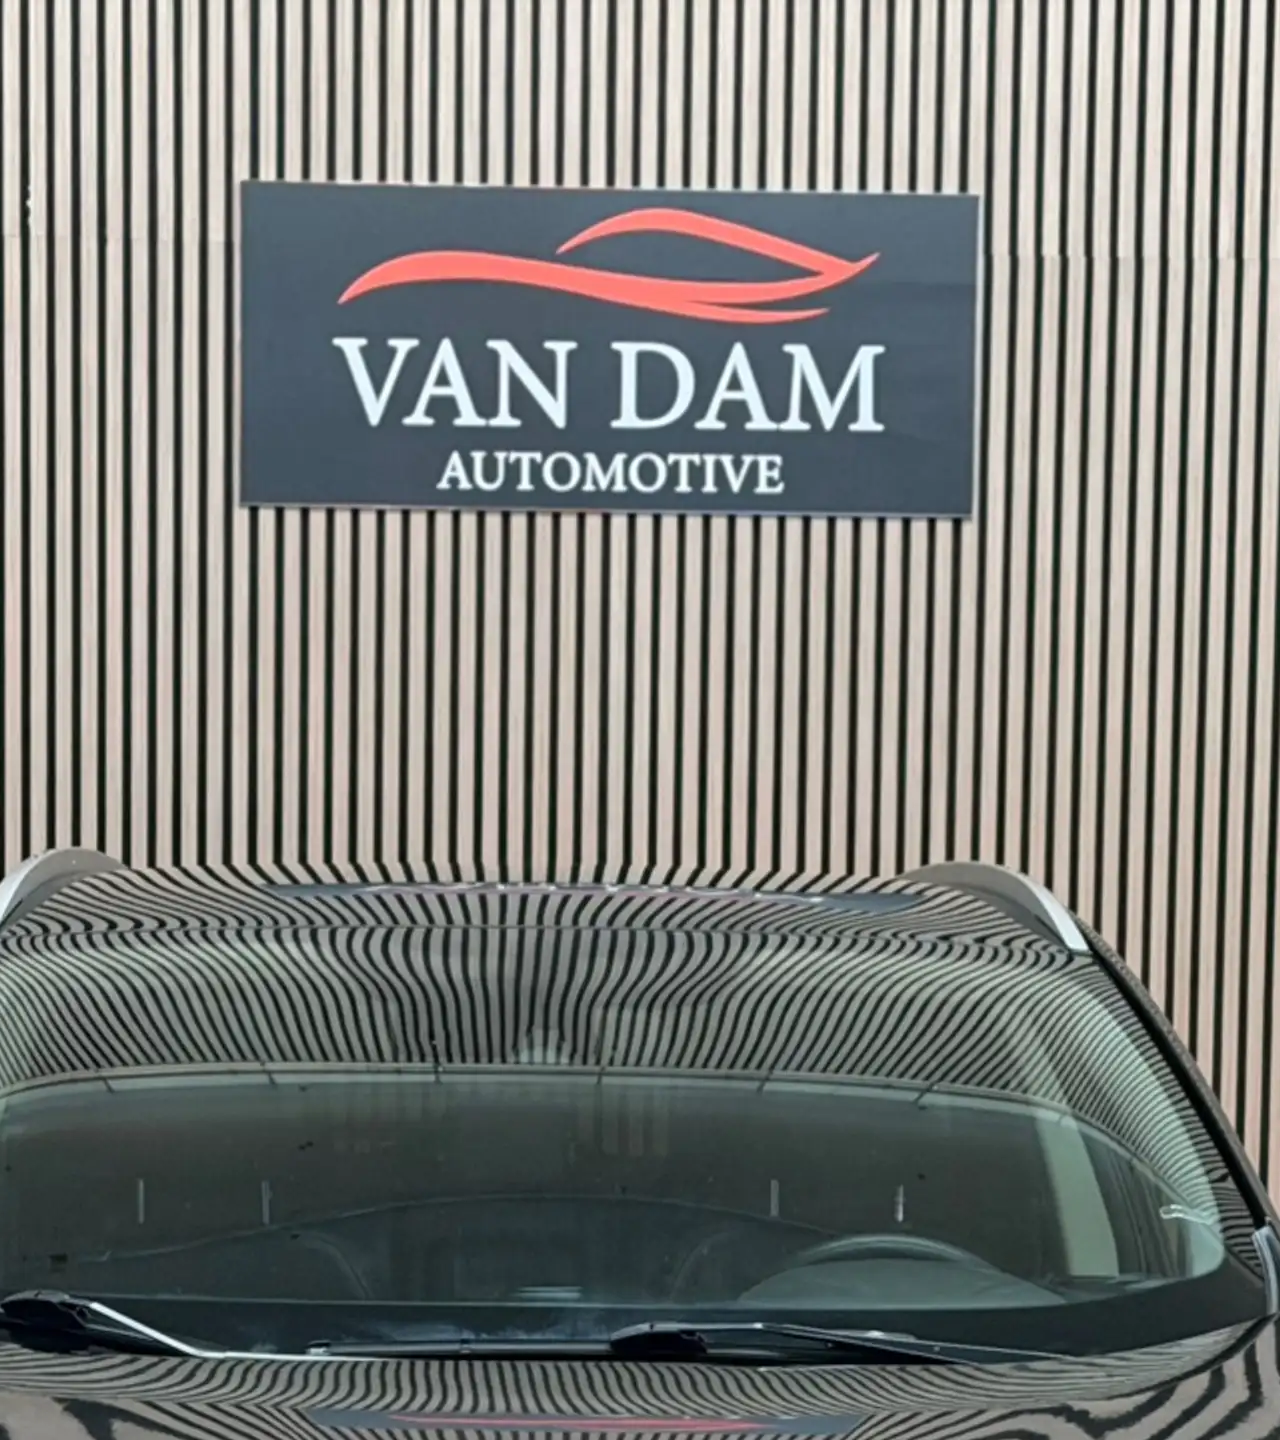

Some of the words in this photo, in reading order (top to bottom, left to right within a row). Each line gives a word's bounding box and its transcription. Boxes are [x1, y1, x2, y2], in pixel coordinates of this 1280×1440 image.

[332, 337, 578, 429] VAN
[610, 341, 886, 433] DAM
[436, 450, 785, 494] AUTOMOTIVE
